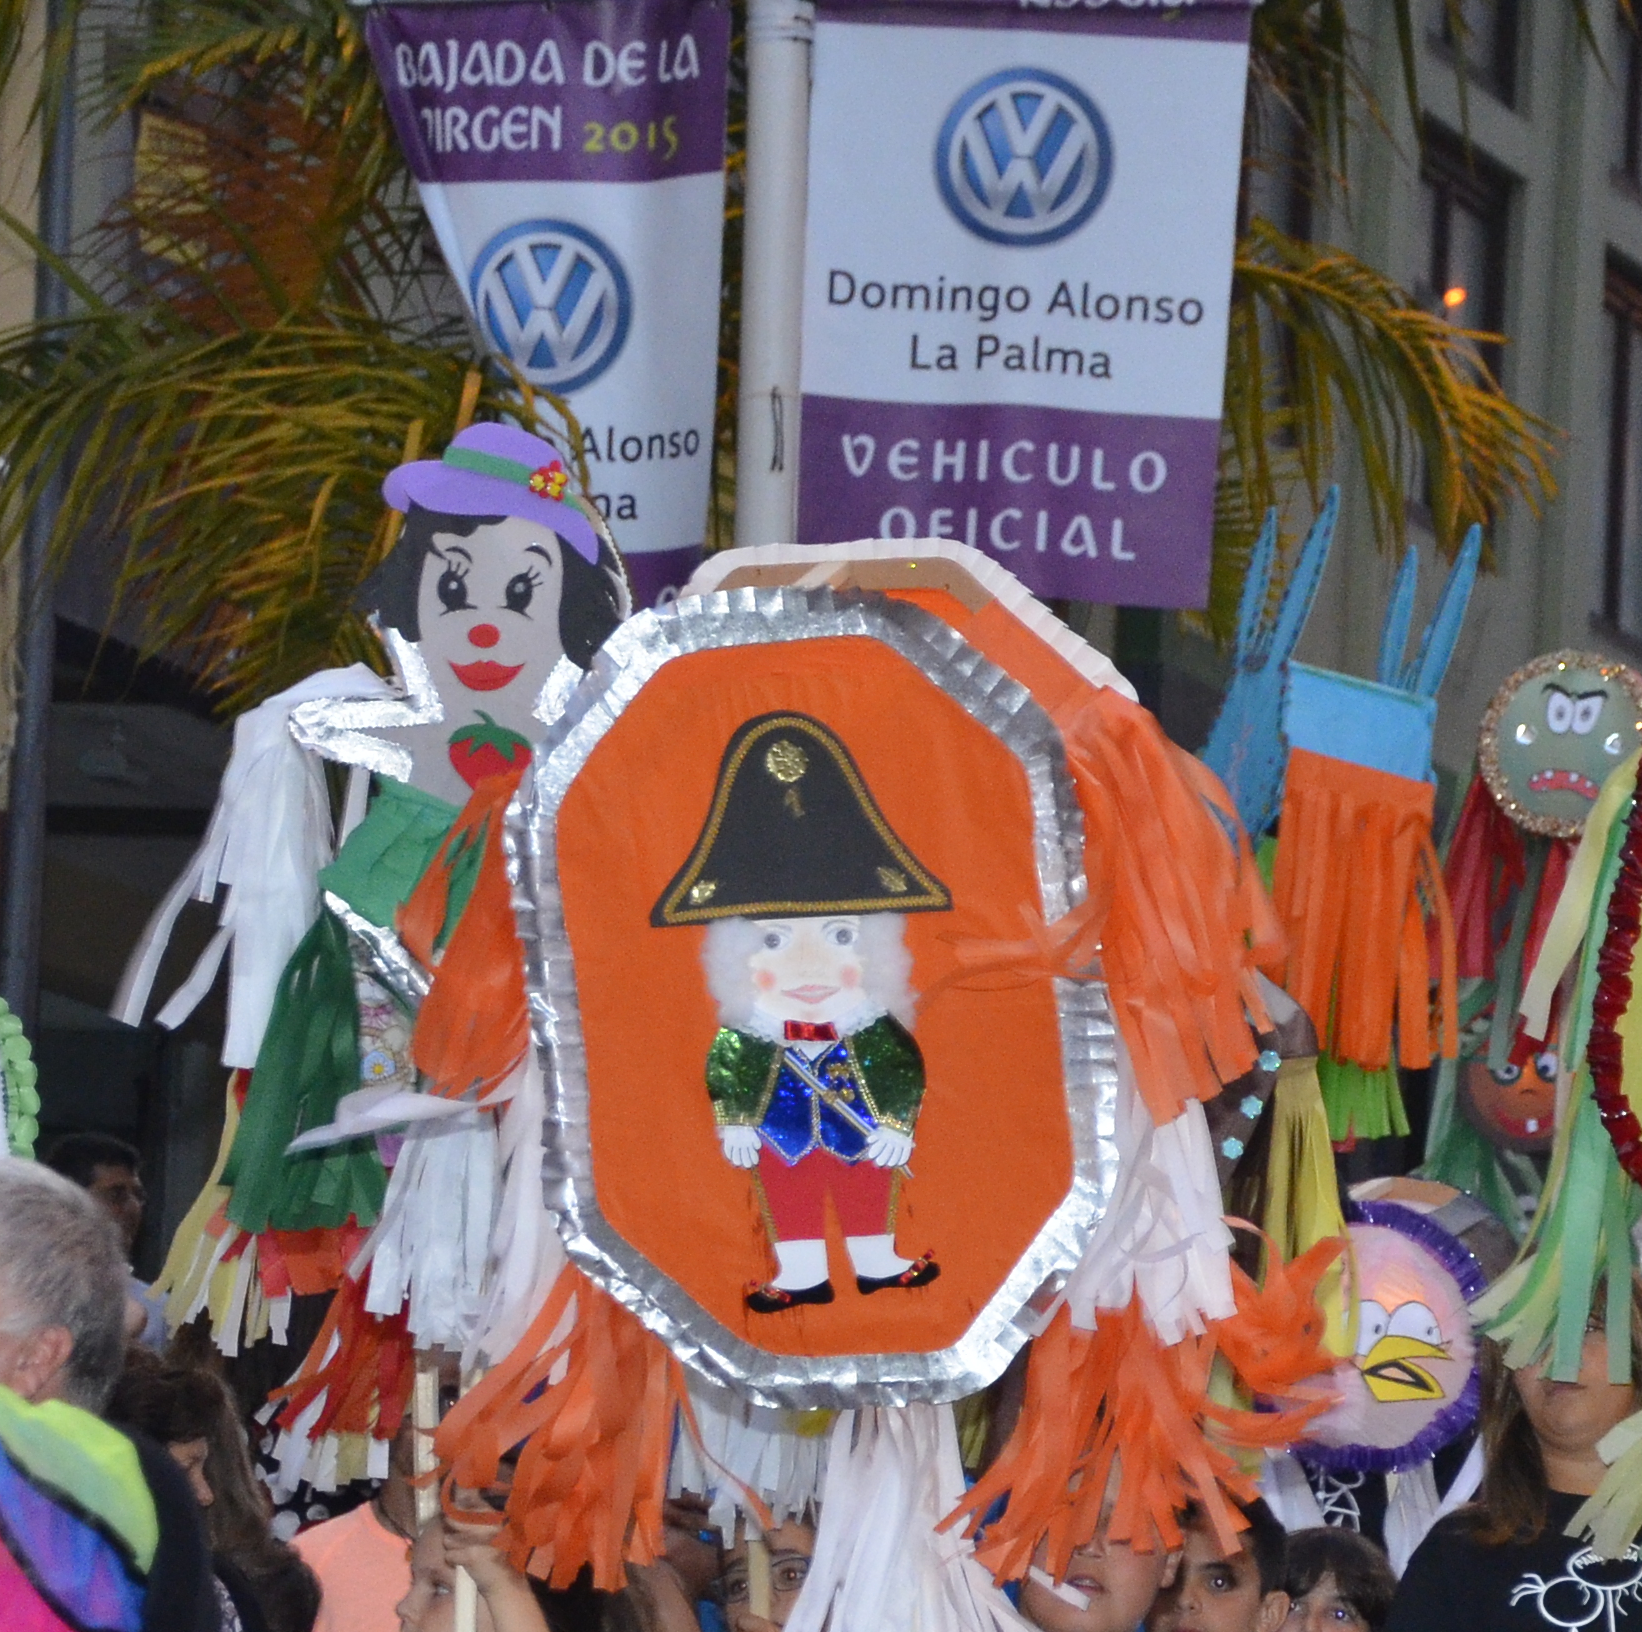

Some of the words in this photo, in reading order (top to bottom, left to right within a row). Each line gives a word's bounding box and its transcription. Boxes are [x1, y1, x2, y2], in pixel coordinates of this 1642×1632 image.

[395, 38, 565, 93] BAJADA
[582, 40, 647, 87] DE
[658, 33, 701, 83] LA
[583, 115, 679, 161] 2015
[828, 269, 1031, 322] Domingo
[1047, 280, 1205, 326] Alonso
[909, 333, 958, 372] La
[976, 334, 1112, 380] Palma
[572, 426, 700, 464] Alonso
[841, 432, 1168, 494] VEHICULO
[879, 506, 1136, 562] OFICIAL
